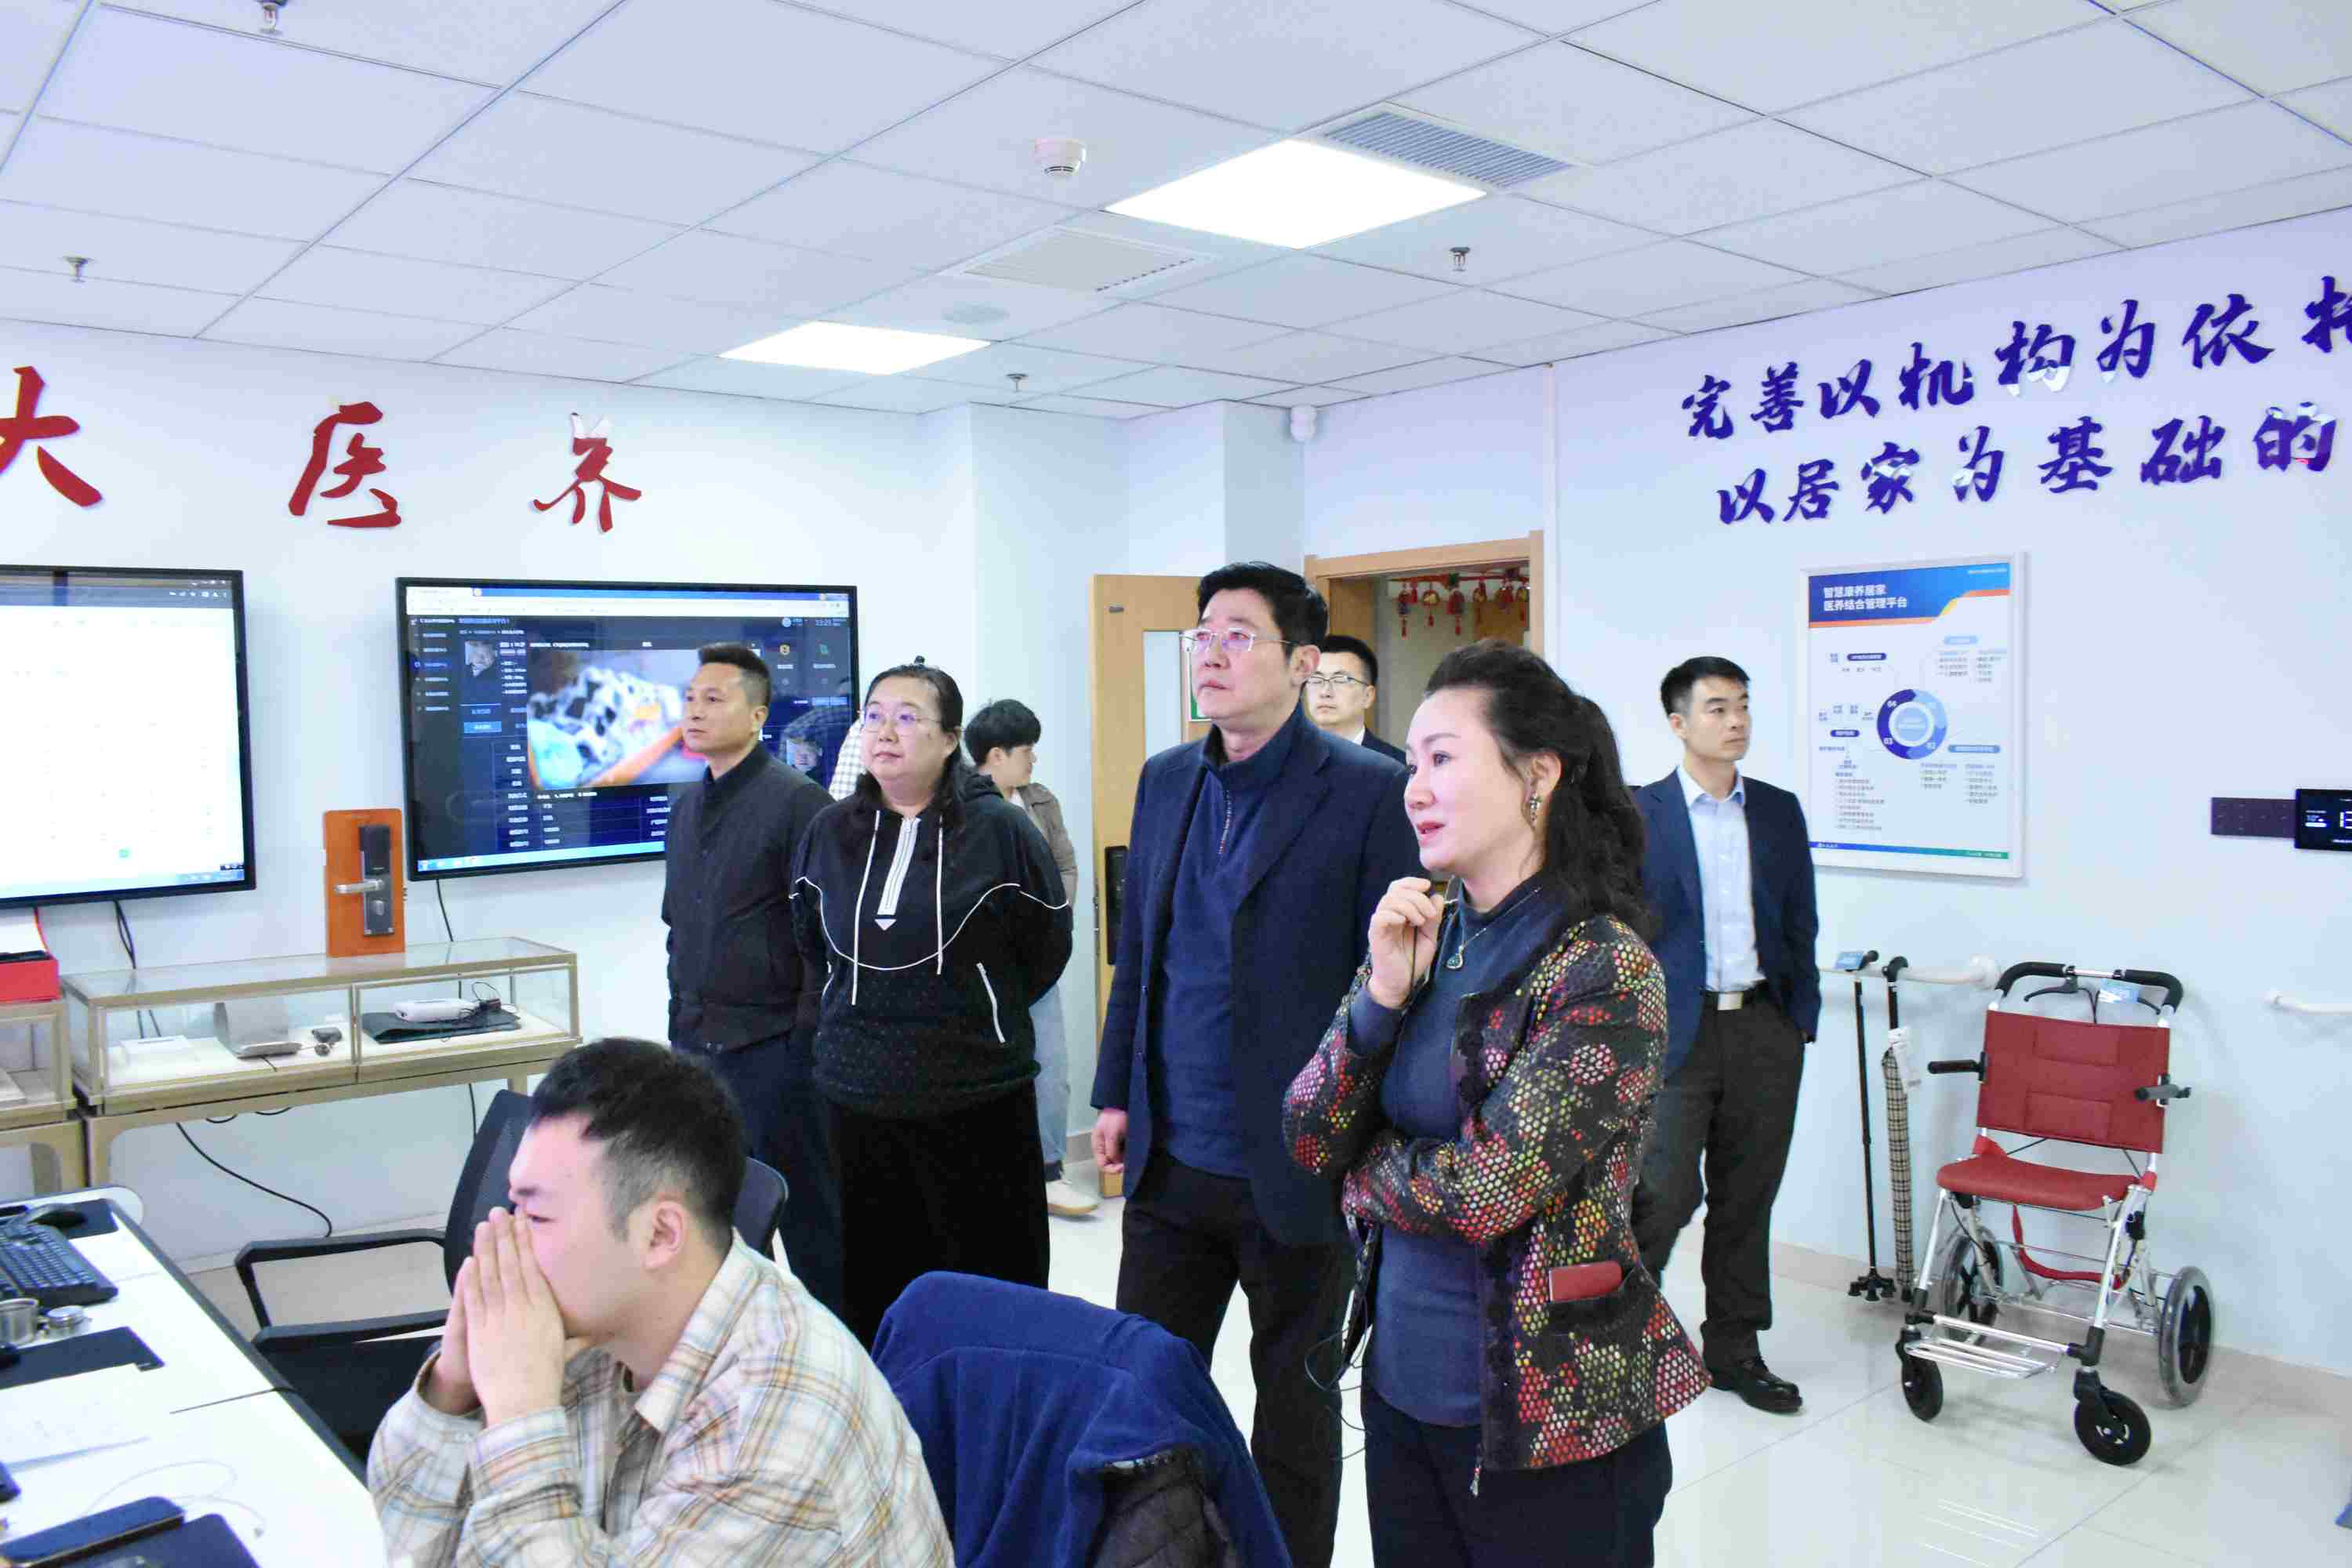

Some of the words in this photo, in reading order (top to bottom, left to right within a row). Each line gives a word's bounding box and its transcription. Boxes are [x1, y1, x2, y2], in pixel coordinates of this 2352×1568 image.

[1719, 401, 2337, 525] 以居家为基础的
[1823, 583, 1886, 599] 智慧康养居家
[1823, 596, 1907, 612] 医养结合管理平台
